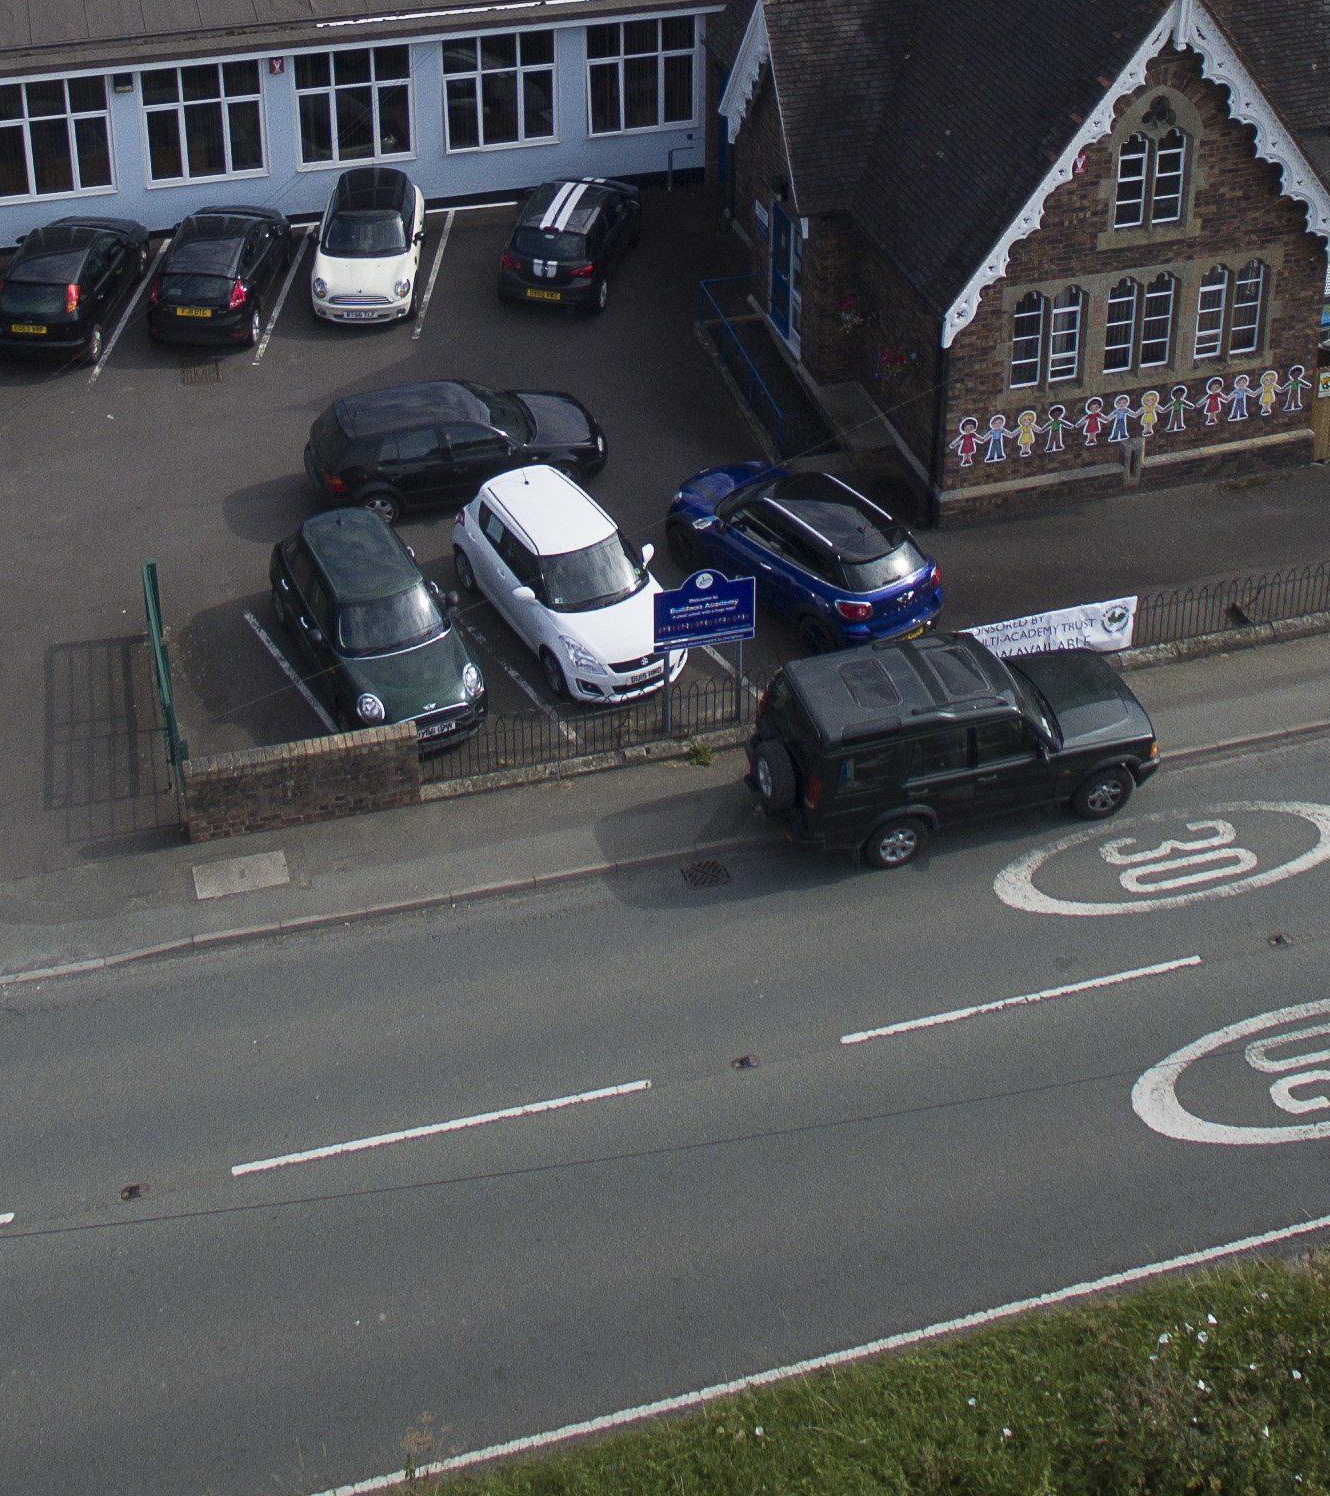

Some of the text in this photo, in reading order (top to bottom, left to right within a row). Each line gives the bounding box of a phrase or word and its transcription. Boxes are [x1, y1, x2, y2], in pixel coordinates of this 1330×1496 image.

[1031, 615, 1045, 625] BY
[1061, 618, 1097, 632] TRUST
[1100, 819, 1258, 893] 30
